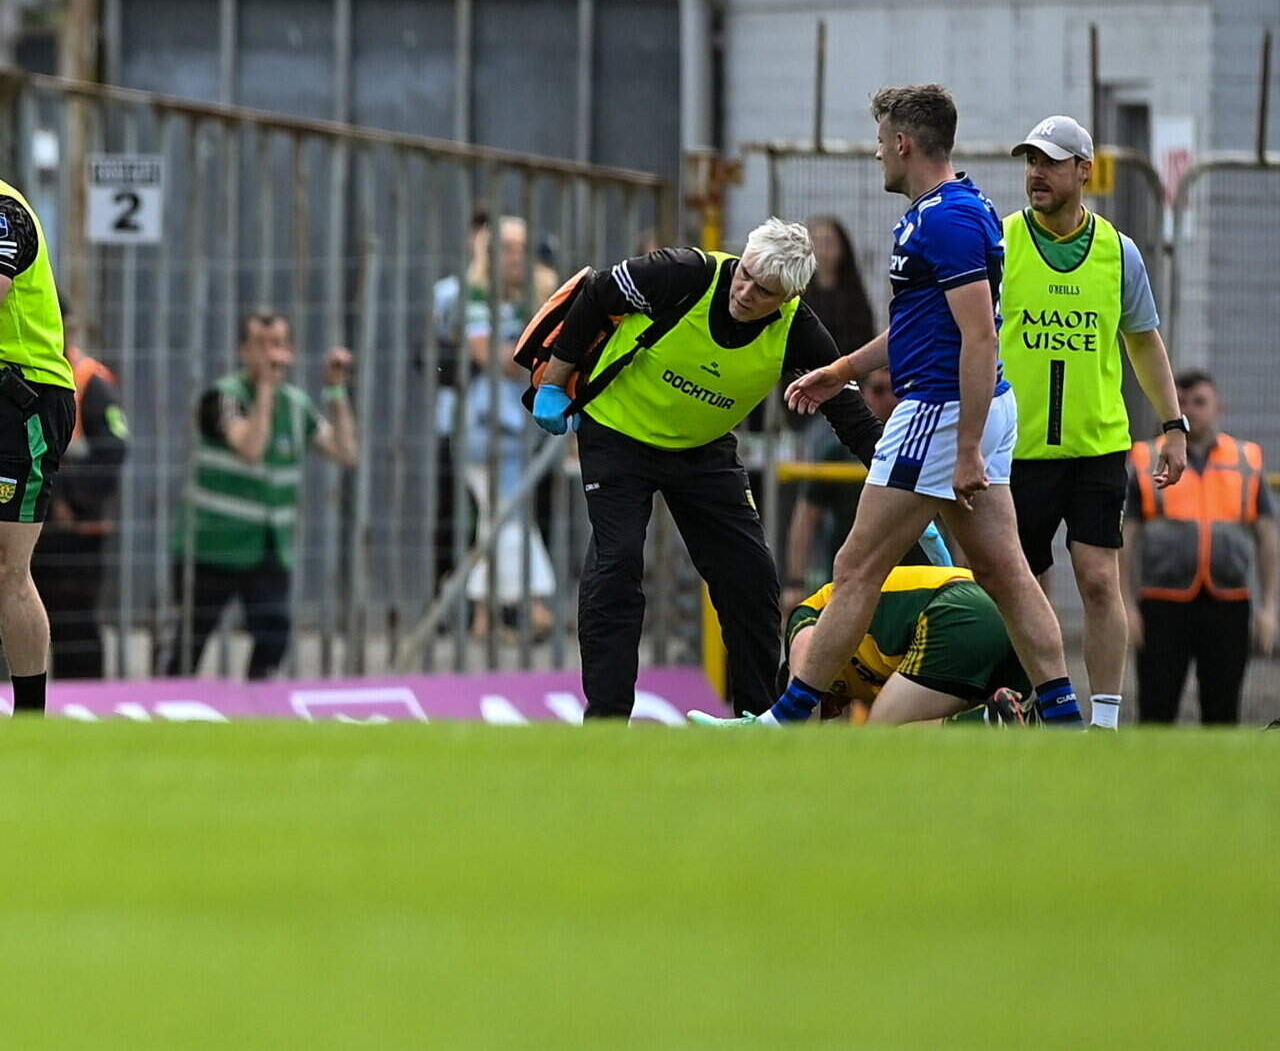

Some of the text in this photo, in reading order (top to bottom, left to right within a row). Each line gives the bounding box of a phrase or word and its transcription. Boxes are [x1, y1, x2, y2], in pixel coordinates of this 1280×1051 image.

[112, 191, 141, 233] 2
[1022, 309, 1098, 329] MAOR
[1022, 331, 1098, 352] UISCE
